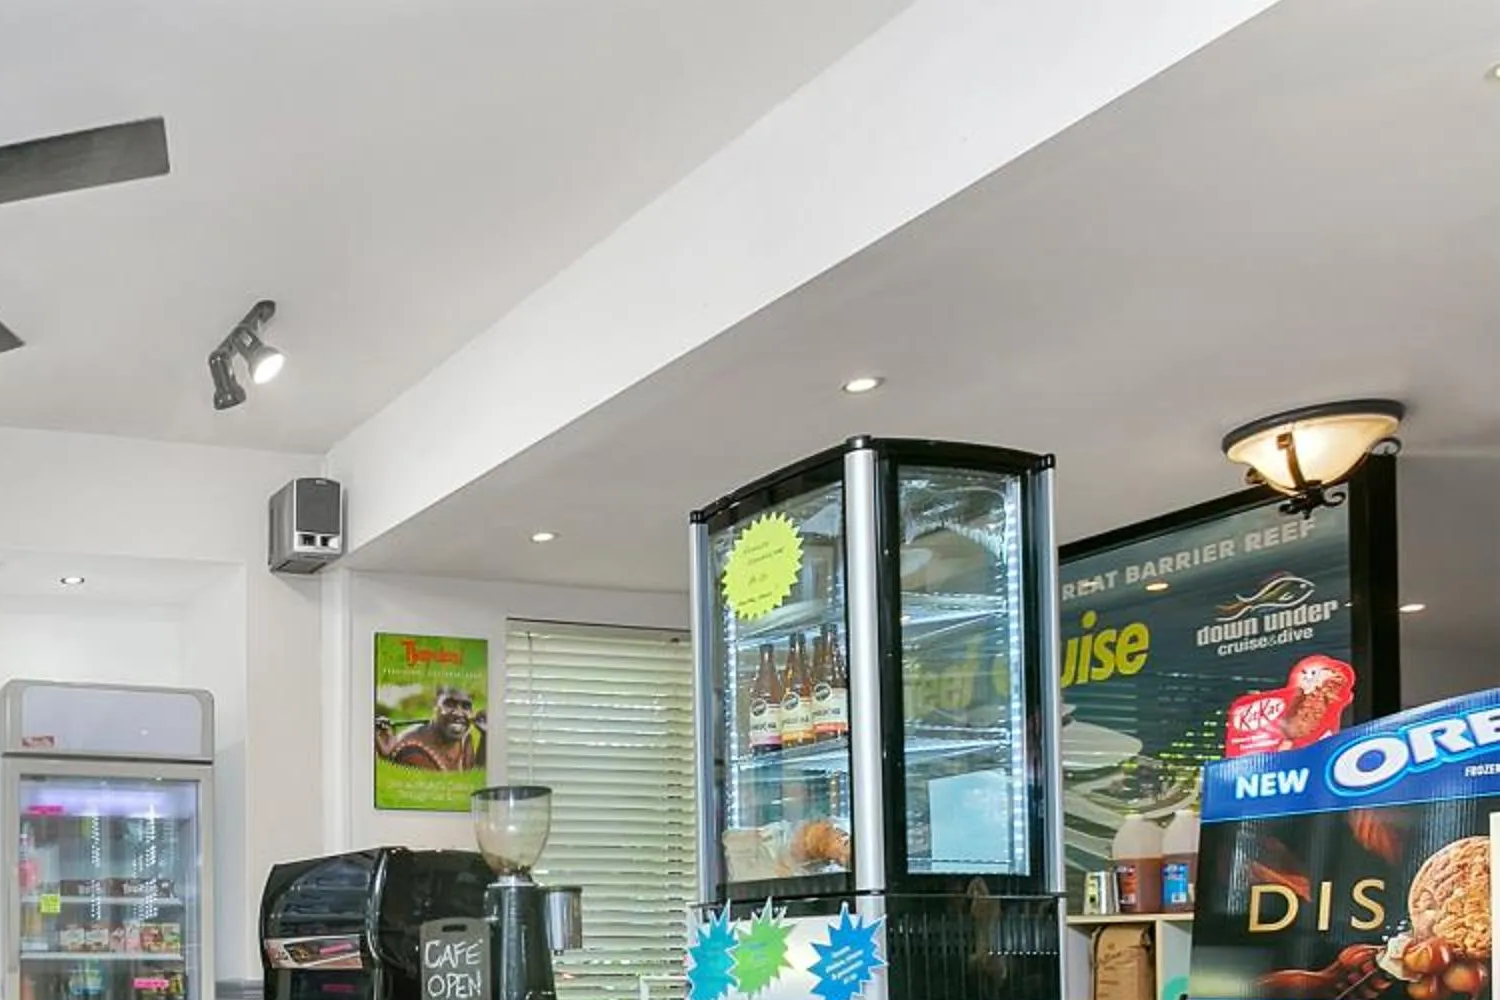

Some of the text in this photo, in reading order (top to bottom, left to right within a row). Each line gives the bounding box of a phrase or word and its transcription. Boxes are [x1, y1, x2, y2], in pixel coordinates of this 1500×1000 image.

[1061, 516, 1316, 600] REAT BARRIER REEF
[1196, 599, 1338, 647] down under
[1235, 707, 1500, 799] NEW ORE
[427, 971, 482, 999] OPEN
